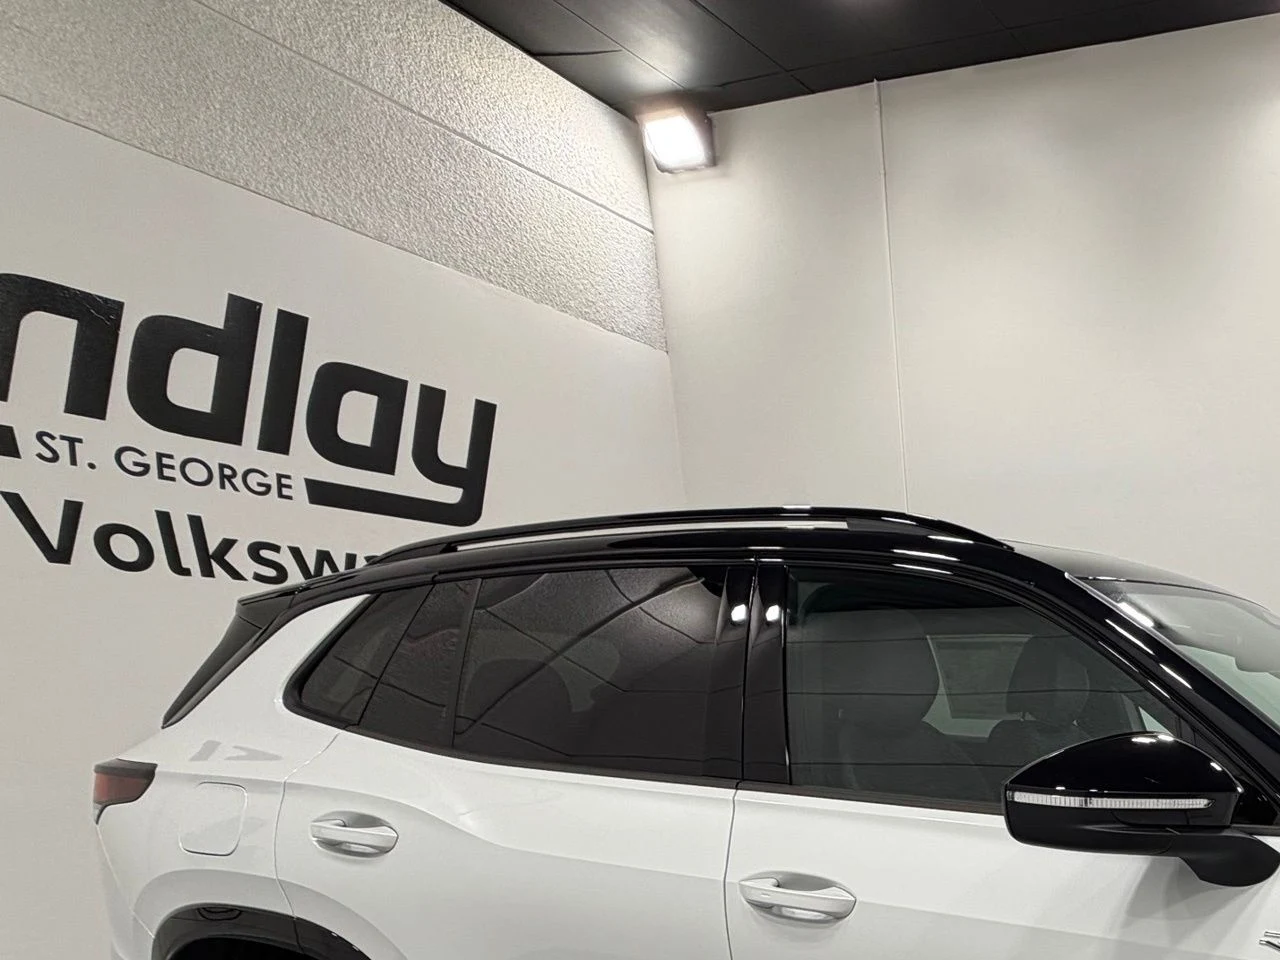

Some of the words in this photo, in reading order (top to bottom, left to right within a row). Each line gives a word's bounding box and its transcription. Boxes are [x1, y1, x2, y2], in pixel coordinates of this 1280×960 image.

[35, 430, 97, 470] ST.
[114, 445, 294, 500] GEORGE
[0, 490, 382, 585] Volksw
